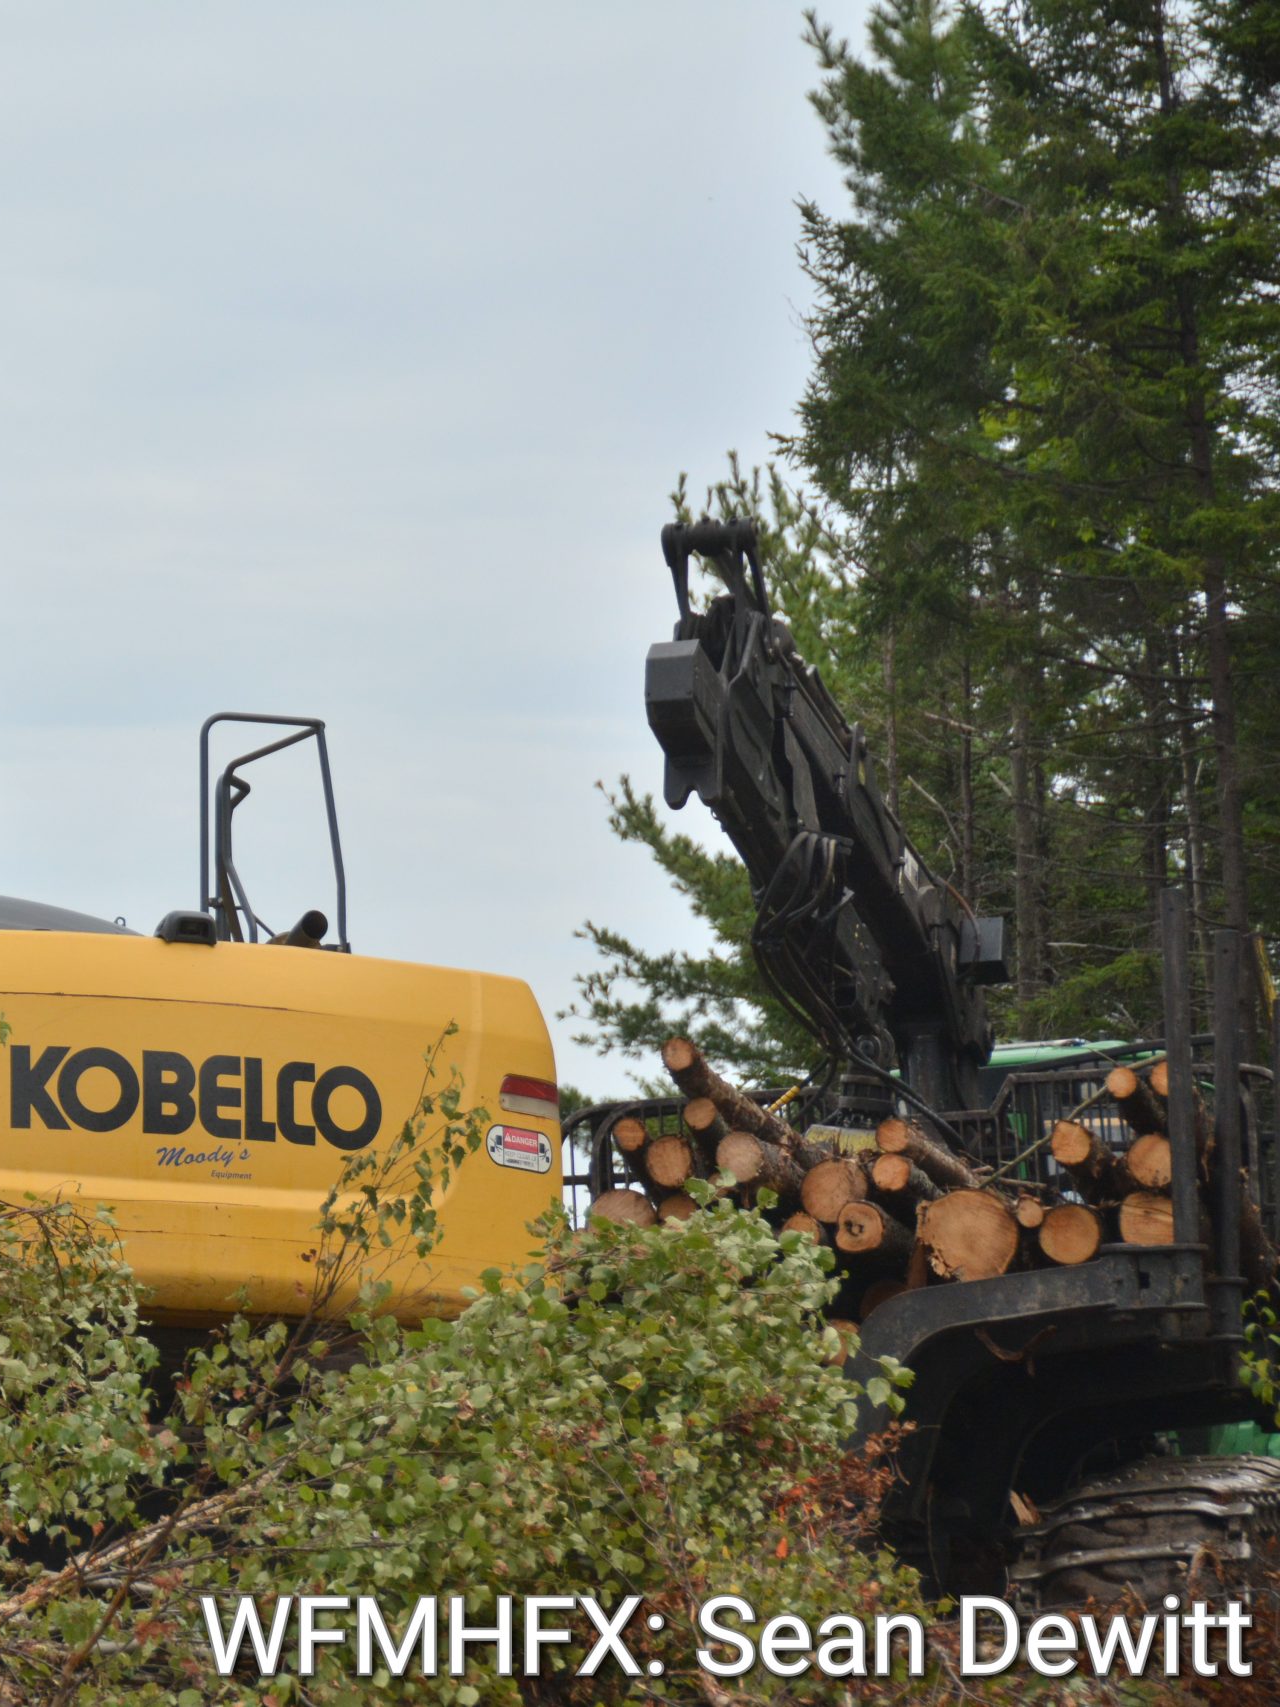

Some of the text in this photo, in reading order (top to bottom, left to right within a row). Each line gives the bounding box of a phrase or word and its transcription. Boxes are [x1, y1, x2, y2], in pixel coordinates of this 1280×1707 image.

[10, 1045, 382, 1151] KOBELCO
[511, 1135, 538, 1147] DANGER
[156, 1142, 251, 1168] Moody's
[211, 1169, 252, 1180] Equipment
